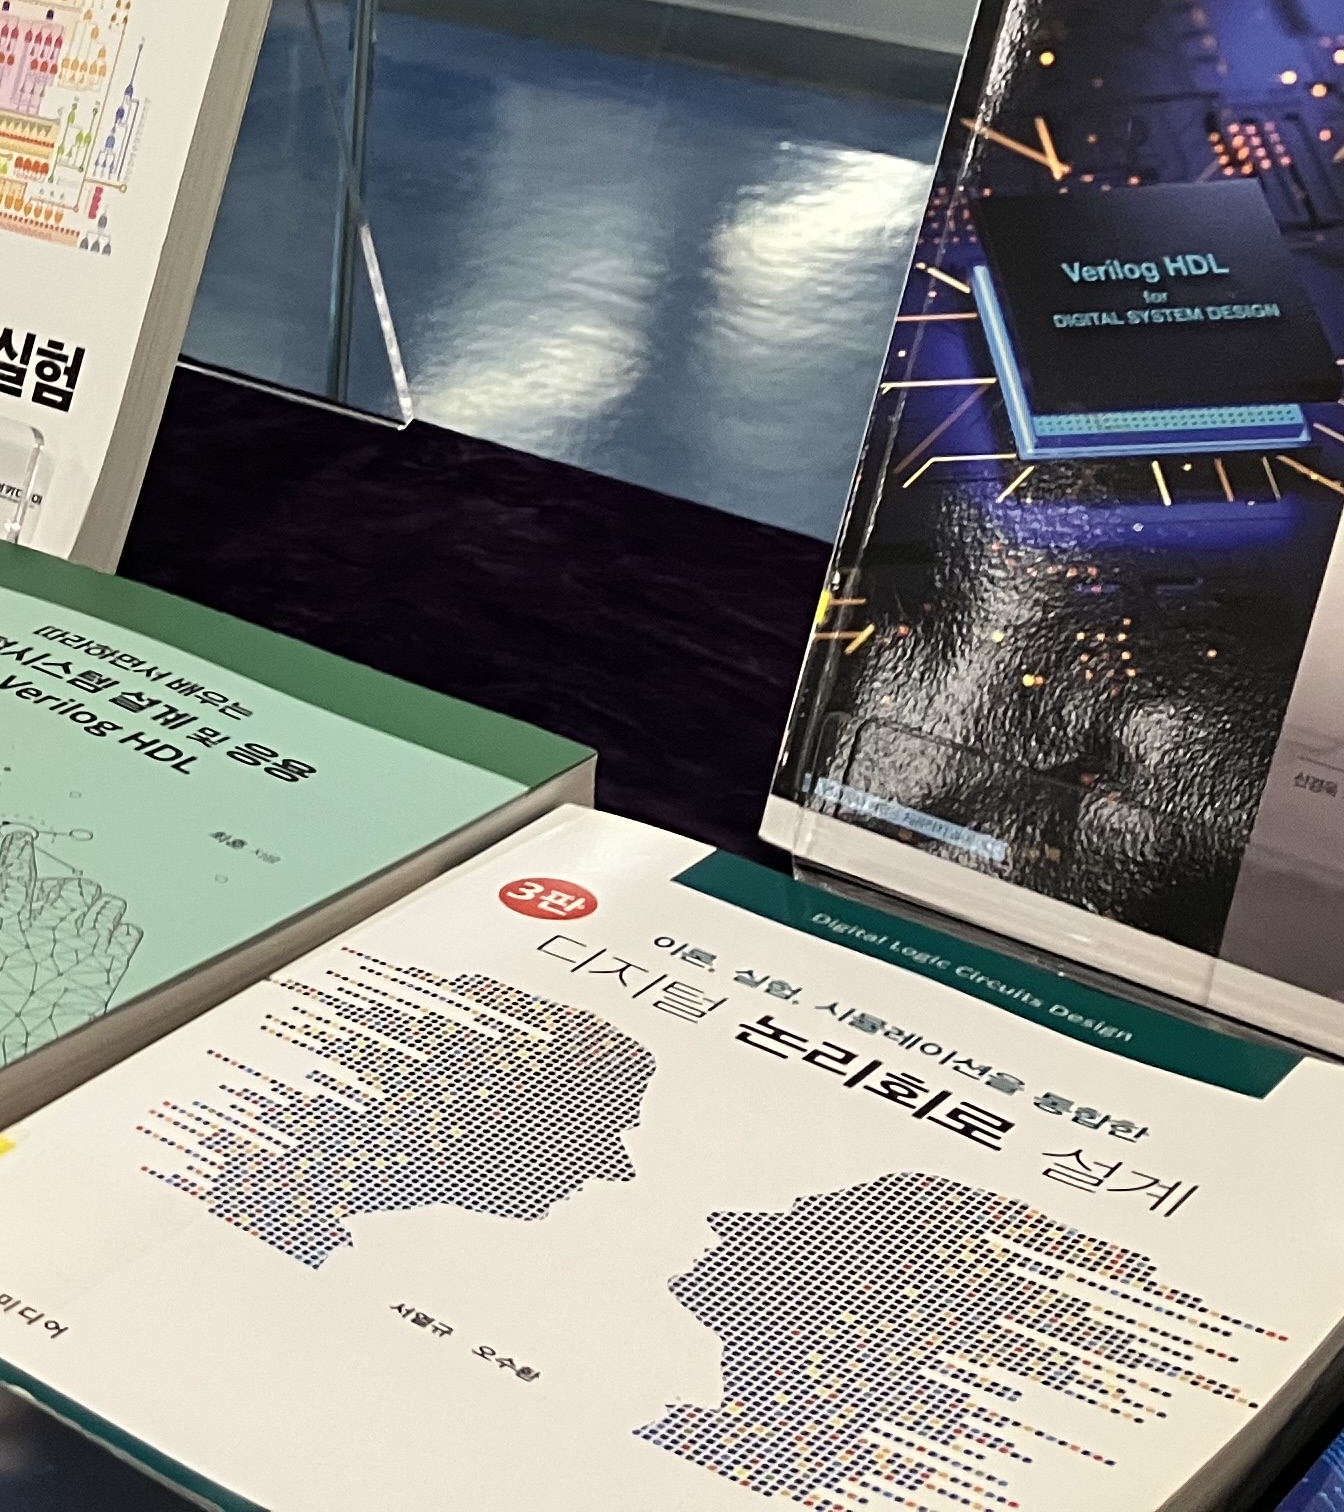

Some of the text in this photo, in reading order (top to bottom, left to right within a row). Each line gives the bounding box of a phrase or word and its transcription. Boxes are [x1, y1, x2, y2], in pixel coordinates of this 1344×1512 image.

[1061, 251, 1231, 286] Verilog HDL
[1143, 287, 1168, 306] for
[1052, 300, 1281, 331] DIGITAL SYSTEM DESIGN
[31, 624, 255, 722] 따라하면서 배우는
[108, 691, 200, 732] 설계
[185, 724, 232, 748] 및
[225, 741, 319, 784] 응용
[116, 731, 204, 776] HDL
[508, 878, 588, 918] 3판
[810, 911, 1135, 1044] Digital Logic Circuits Design
[534, 932, 1202, 1218] 디지털 논리회로 설계
[814, 999, 1028, 1097] 시뮬레이션을
[1033, 1088, 1152, 1144] 통합한
